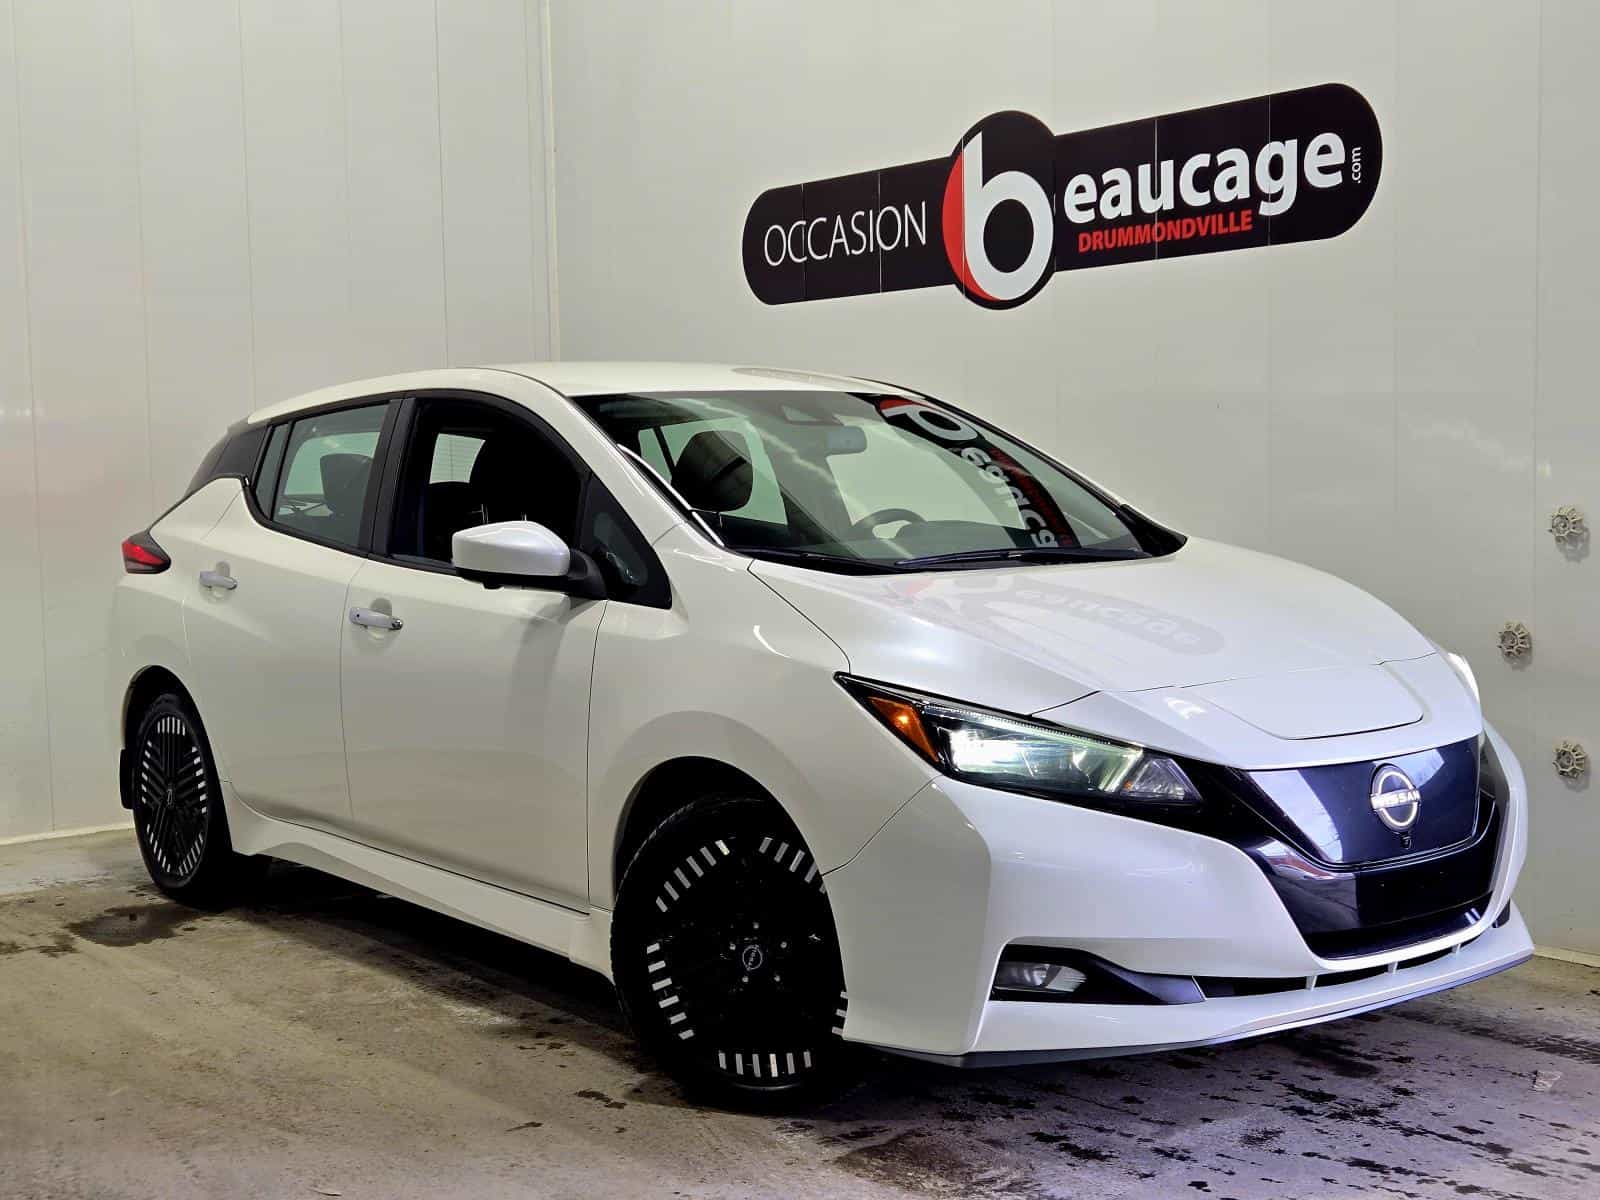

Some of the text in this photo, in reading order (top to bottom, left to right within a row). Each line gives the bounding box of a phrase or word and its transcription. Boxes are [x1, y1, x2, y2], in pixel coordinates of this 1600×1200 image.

[1351, 146, 1362, 184] .com
[764, 200, 927, 267] OCCASION
[1077, 210, 1253, 253] DRUMMONDVILLE
[1371, 790, 1420, 808] SSAN
